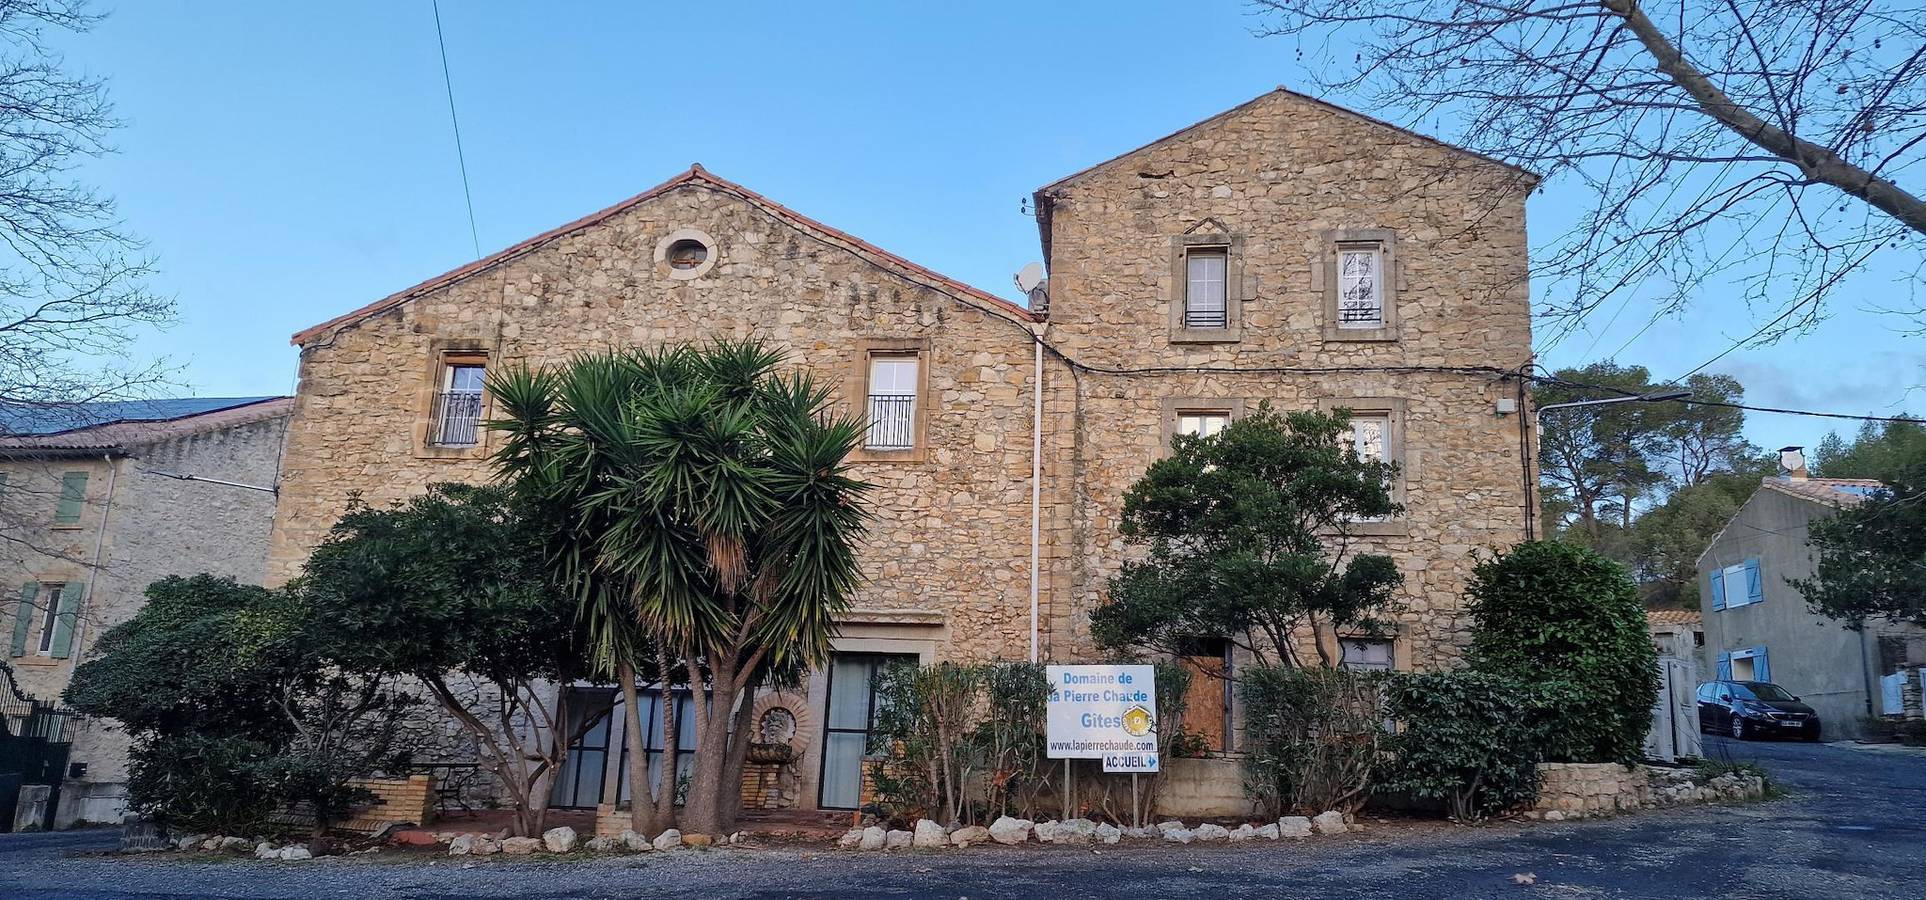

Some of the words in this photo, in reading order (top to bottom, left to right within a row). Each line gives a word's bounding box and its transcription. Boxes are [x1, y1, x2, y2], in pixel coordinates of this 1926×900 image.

[1063, 672, 1115, 685] Domaine
[1118, 672, 1133, 685] de
[1064, 690, 1100, 702] Pierre
[1103, 690, 1148, 702] Chaude
[1050, 740, 1154, 752] www.lapierrechaude.com
[1106, 757, 1146, 767] ACCUEIL
